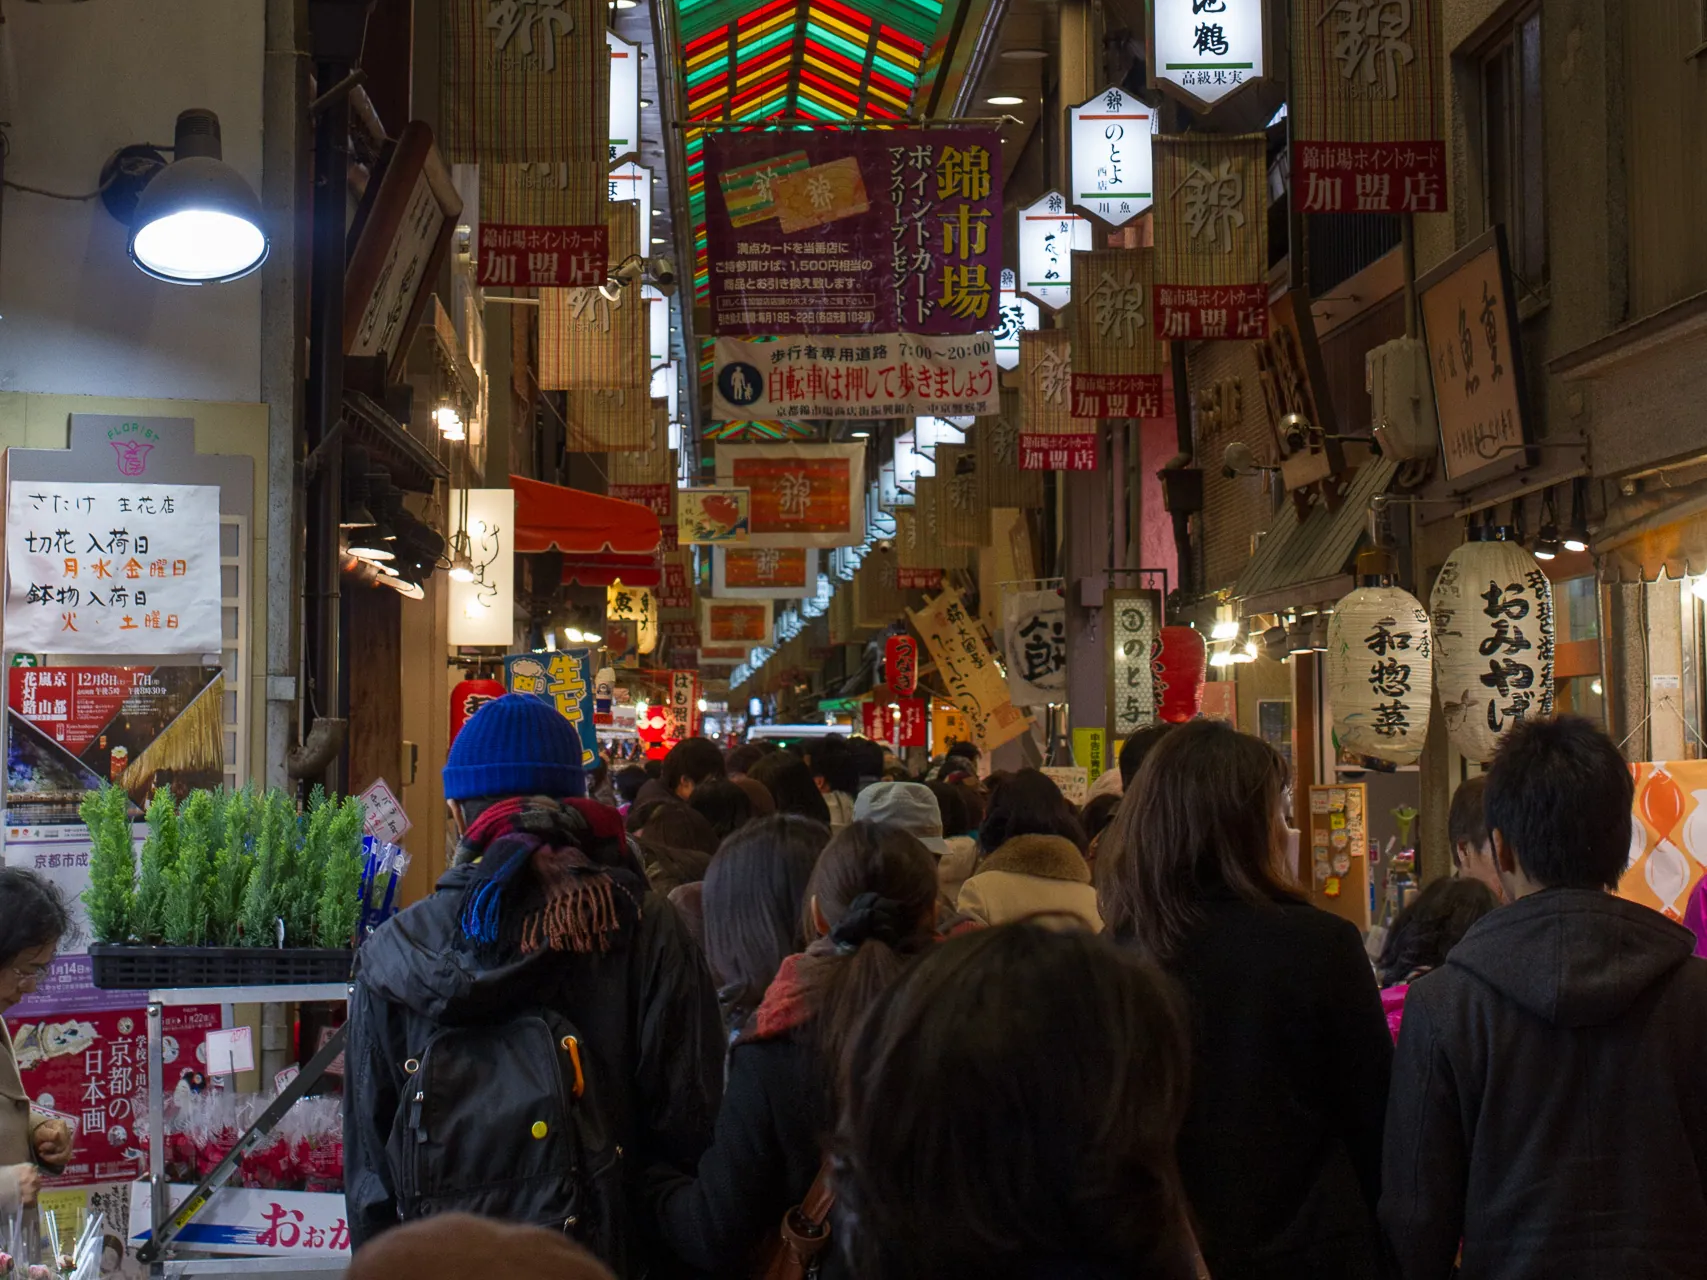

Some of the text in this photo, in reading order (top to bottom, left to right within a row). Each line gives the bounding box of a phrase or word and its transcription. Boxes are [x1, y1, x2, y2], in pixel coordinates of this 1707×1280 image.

[486, 55, 544, 71] NISHIKI
[1182, 70, 1243, 86] 高級果実
[1103, 90, 1123, 113] 錦
[1104, 123, 1124, 185] のとよ
[1302, 145, 1440, 171] 錦市場ポイントカード
[1302, 171, 1440, 211] 加盟店
[1169, 155, 1246, 254] 錦
[482, 227, 603, 250] 錦市場ポイントカード
[908, 144, 935, 325] ポイントカード
[936, 144, 992, 319] 錦市場
[737, 242, 849, 255] 満点カードを当番店に
[482, 250, 603, 286] 加盟店
[1083, 268, 1145, 348] 錦
[1159, 289, 1264, 308] 錦市場ポイントカード
[1160, 307, 1264, 338] 加盟店
[770, 344, 888, 364] 歩行者専用道路
[768, 359, 993, 404] 自転車は押して歩きましょう
[1075, 376, 1160, 392] 錦市場ポイントカード
[927, 401, 988, 414] 中京警察署
[1075, 391, 1159, 417] 加盟店
[107, 422, 160, 441] FLORIST
[1022, 435, 1094, 449] 錦市場ポイントカード
[1022, 449, 1094, 470] 加盟店
[28, 493, 176, 515] さたけ 生花店
[25, 527, 149, 555] 切花 入荷日
[26, 582, 147, 608] 鉢物 入荷日
[1479, 579, 1535, 733] おみやげ
[1364, 617, 1413, 738] 和惣菜
[107, 1036, 132, 1120] 京都の
[80, 1049, 107, 1137] 日本画
